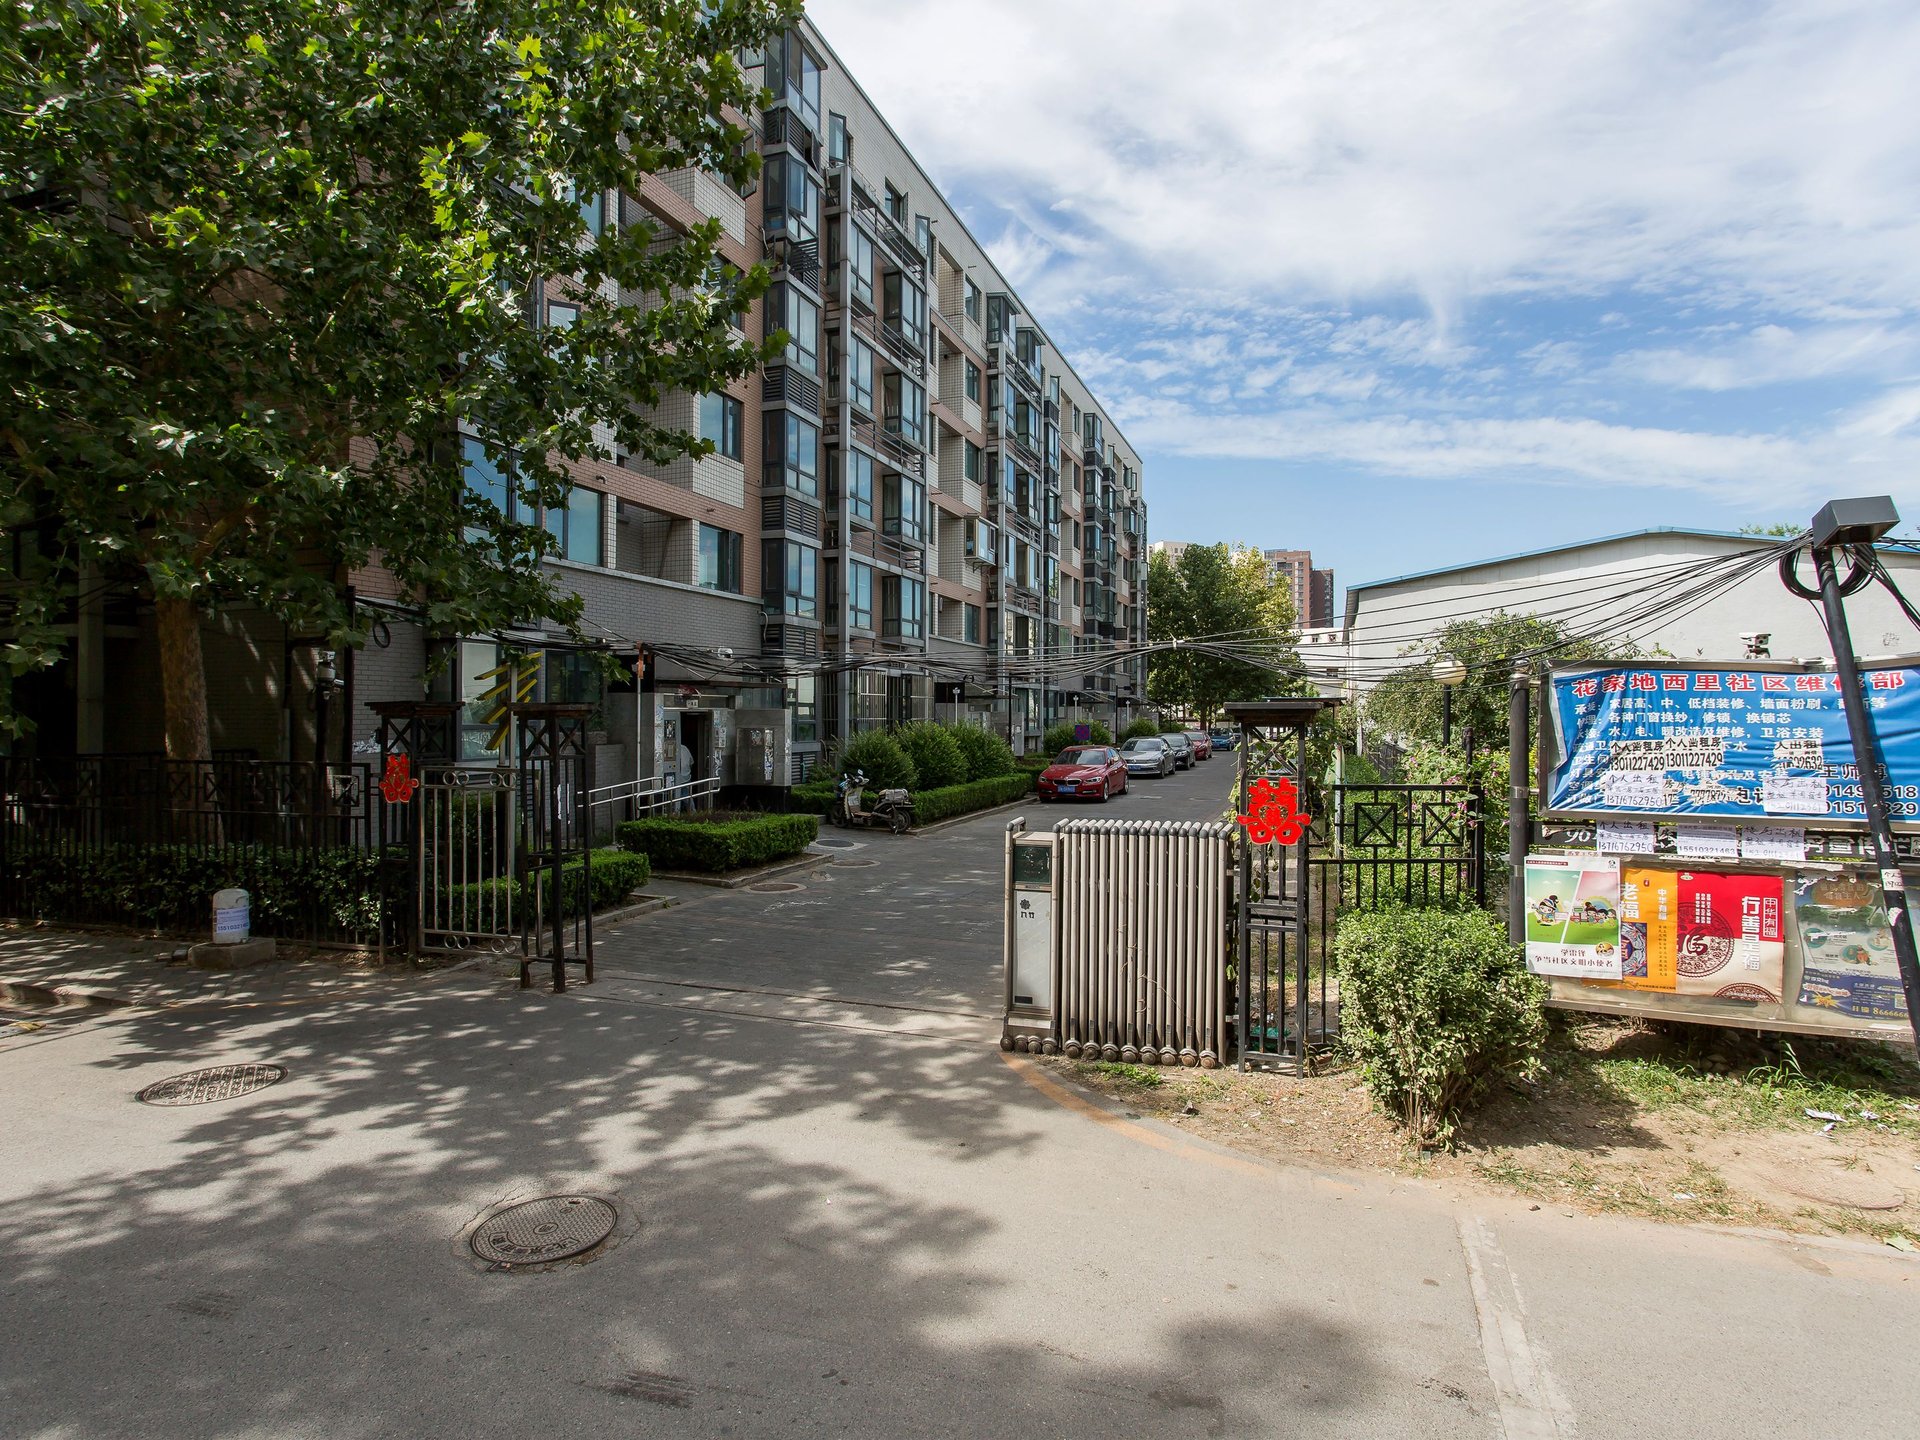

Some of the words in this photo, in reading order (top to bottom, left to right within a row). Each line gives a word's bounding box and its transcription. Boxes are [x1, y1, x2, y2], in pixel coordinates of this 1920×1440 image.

[1611, 756, 1665, 772] 13011227429
[1666, 752, 1723, 767] 13011227429
[1764, 898, 1777, 937] 中华有福
[1741, 895, 1761, 971] 行善是福
